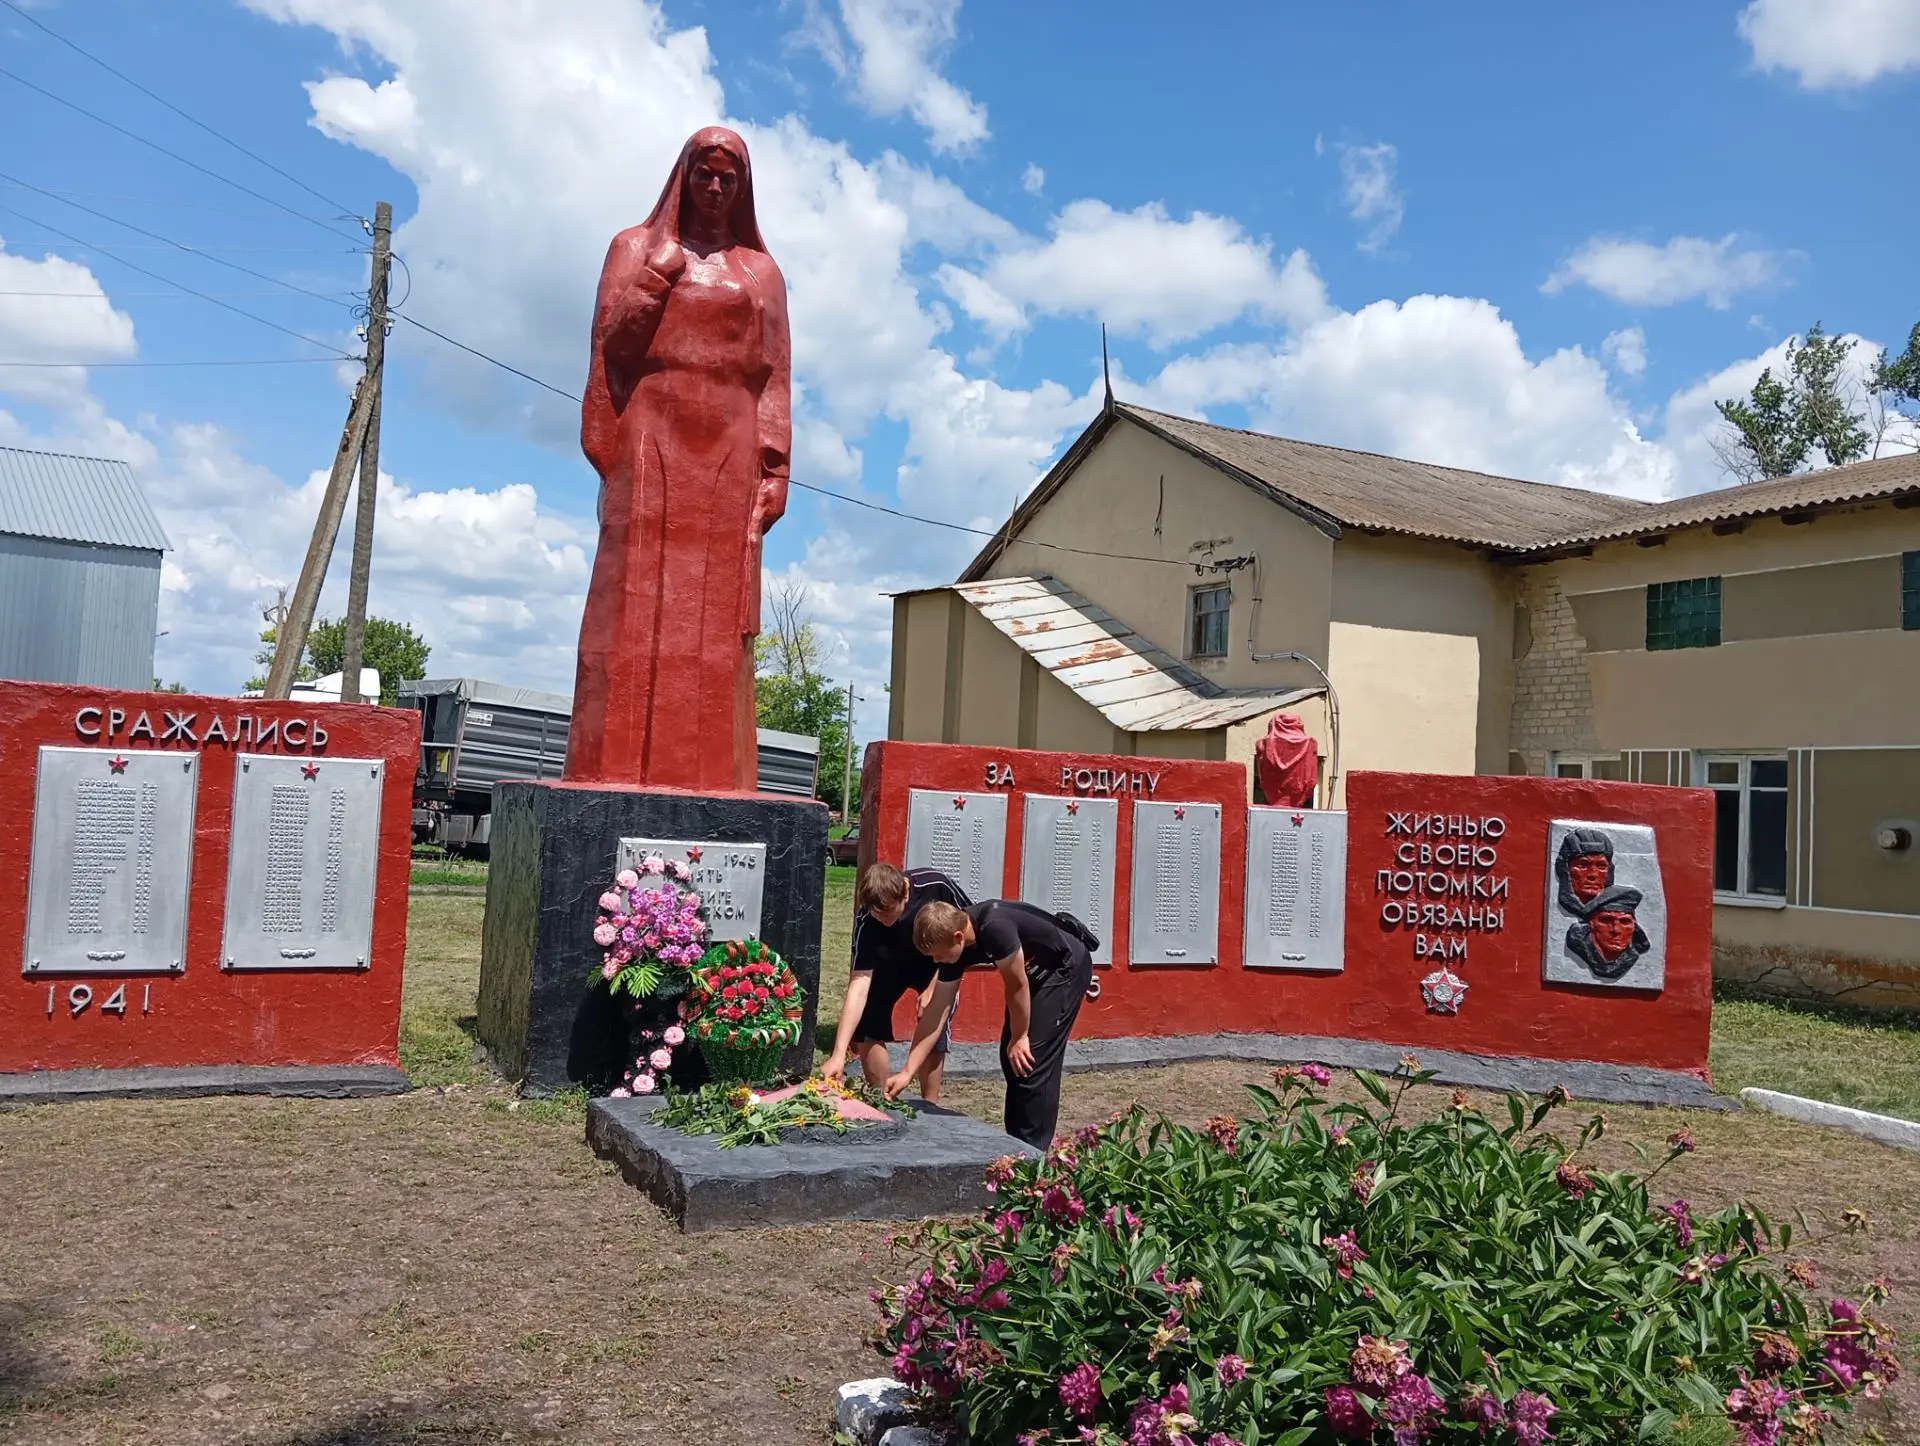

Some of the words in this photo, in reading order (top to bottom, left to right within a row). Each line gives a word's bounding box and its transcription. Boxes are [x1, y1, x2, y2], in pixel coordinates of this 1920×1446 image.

[75, 706, 329, 748] СРАЖАЛИСЬ
[985, 762, 1016, 787] ЗА
[1060, 766, 1161, 795] РОДИНУ
[1385, 812, 1506, 838] ЖИЗНЬЮ
[724, 852, 756, 869] 1945
[1397, 843, 1498, 867] СВОЕЮ
[1375, 869, 1509, 899] ПОТОМКИ
[1381, 901, 1504, 930] ОБЯЗАНЫ
[1415, 934, 1468, 959] ВАМ
[46, 983, 152, 1018] 1941
